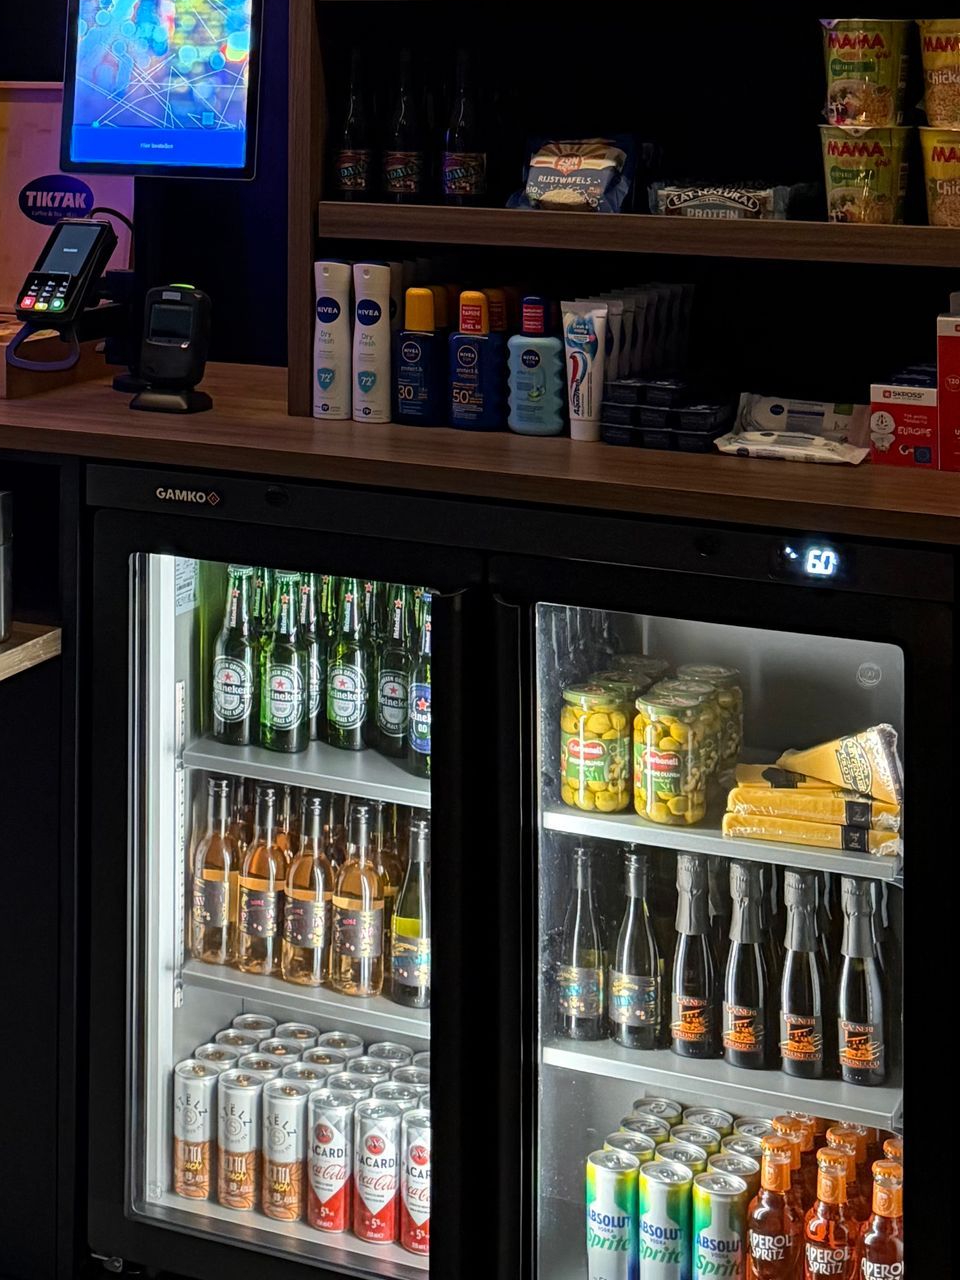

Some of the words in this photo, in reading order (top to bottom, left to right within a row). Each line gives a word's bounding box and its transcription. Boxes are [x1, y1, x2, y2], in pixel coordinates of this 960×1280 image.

[828, 36, 884, 50] MAMA
[924, 37, 960, 53] MAM
[926, 69, 960, 85] Chicke
[828, 141, 884, 157] MAMA
[932, 147, 960, 163] MA
[538, 175, 591, 185] RIJSTWAFELS
[937, 180, 960, 196] Chic
[25, 190, 87, 208] TIKTAK
[673, 190, 694, 205] EAT
[698, 187, 755, 209] NATURAL
[687, 209, 739, 219] PROTEIN
[398, 385, 413, 400] 30
[892, 390, 922, 399] SKROSS
[156, 487, 206, 503] GAMKO
[215, 682, 251, 695] eineken
[270, 691, 303, 701] ineken
[329, 689, 366, 700] eineken
[379, 696, 408, 707] eineke
[588, 1230, 630, 1253] Sprite
[696, 1236, 741, 1253] ABSOLU
[749, 1233, 793, 1251] APEROL
[639, 1239, 684, 1265] Sprite
[752, 1248, 785, 1261] SPRITZ
[805, 1243, 851, 1263] APEROL
[809, 1257, 843, 1275] SPRITZ
[861, 1257, 904, 1278] APERO
